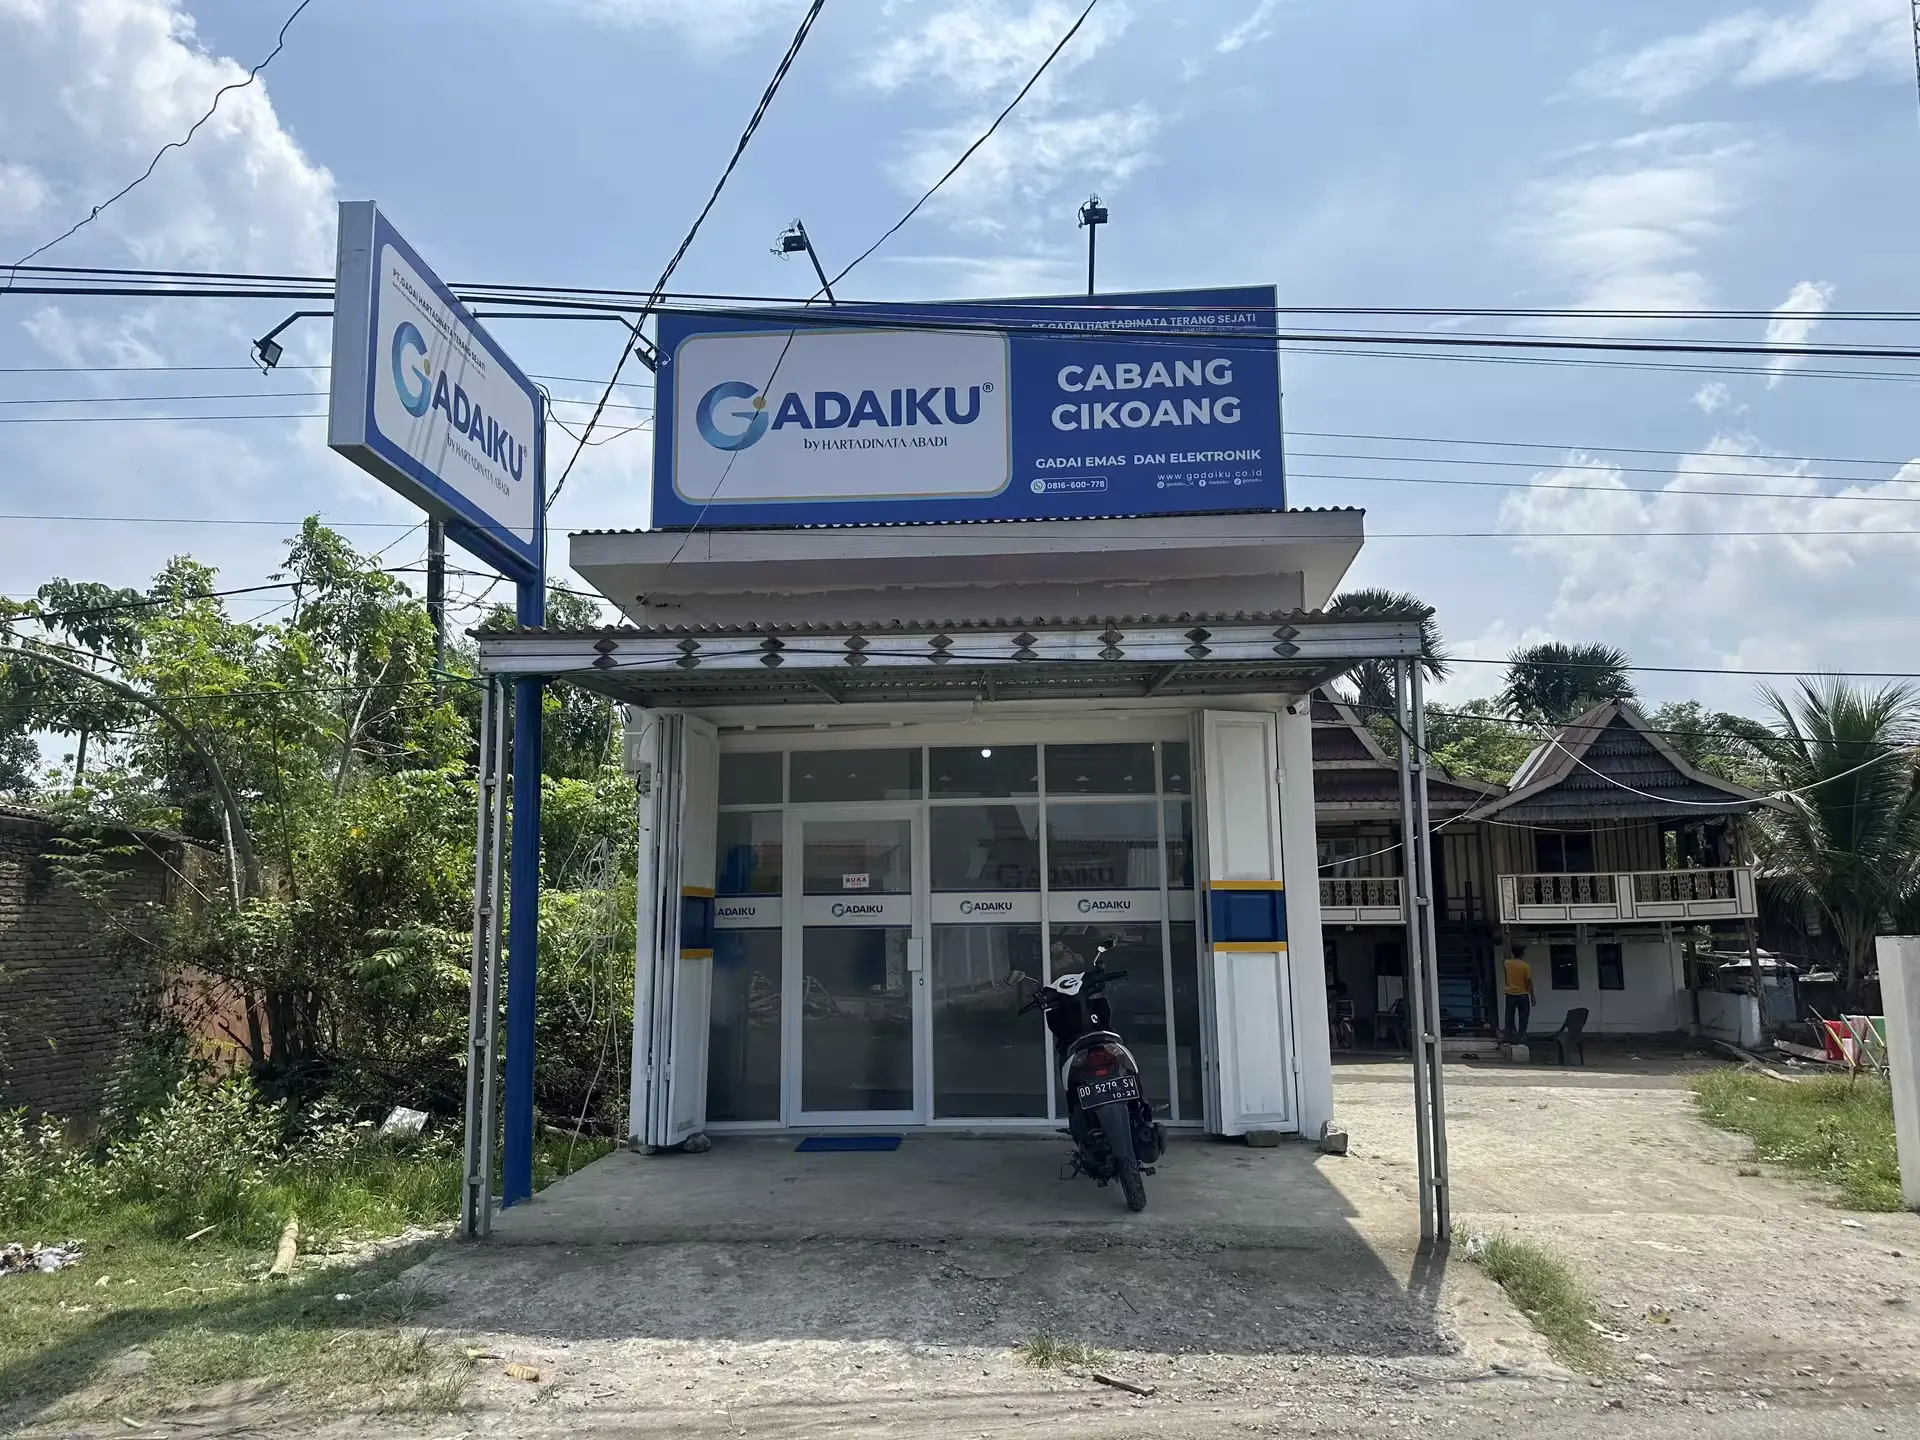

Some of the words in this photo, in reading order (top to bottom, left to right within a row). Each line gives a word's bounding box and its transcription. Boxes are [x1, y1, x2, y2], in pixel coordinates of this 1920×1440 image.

[1170, 315, 1216, 326] TERANG
[1217, 313, 1256, 324] SEJATI
[1057, 358, 1233, 392] CABANG
[392, 322, 523, 482] GADAIKU
[696, 381, 981, 451] GADAIKU
[1051, 396, 1241, 431] CIKOANG
[803, 438, 820, 451] by
[822, 437, 907, 450] HARTADINATA
[908, 435, 948, 448] ABADI
[447, 432, 456, 453] by
[455, 441, 494, 485] HARTADINATA
[493, 476, 510, 497] ABADI
[1035, 457, 1082, 469] GADAI
[1085, 455, 1126, 467] EMAS
[1133, 453, 1166, 465] DAN
[1169, 449, 1262, 464] ELEKTRONIK
[1157, 469, 1262, 482] www.gadaiku.co.id
[1046, 480, 1105, 490] 0816-600-778
[716, 907, 756, 916] ADAIKU
[831, 902, 884, 917] GADAIKU
[960, 900, 1013, 914] GADAIKU
[1077, 898, 1131, 913] GADAIKU
[1080, 1086, 1091, 1097] DD
[1095, 1081, 1118, 1093] 5279
[1122, 1078, 1134, 1088] SV
